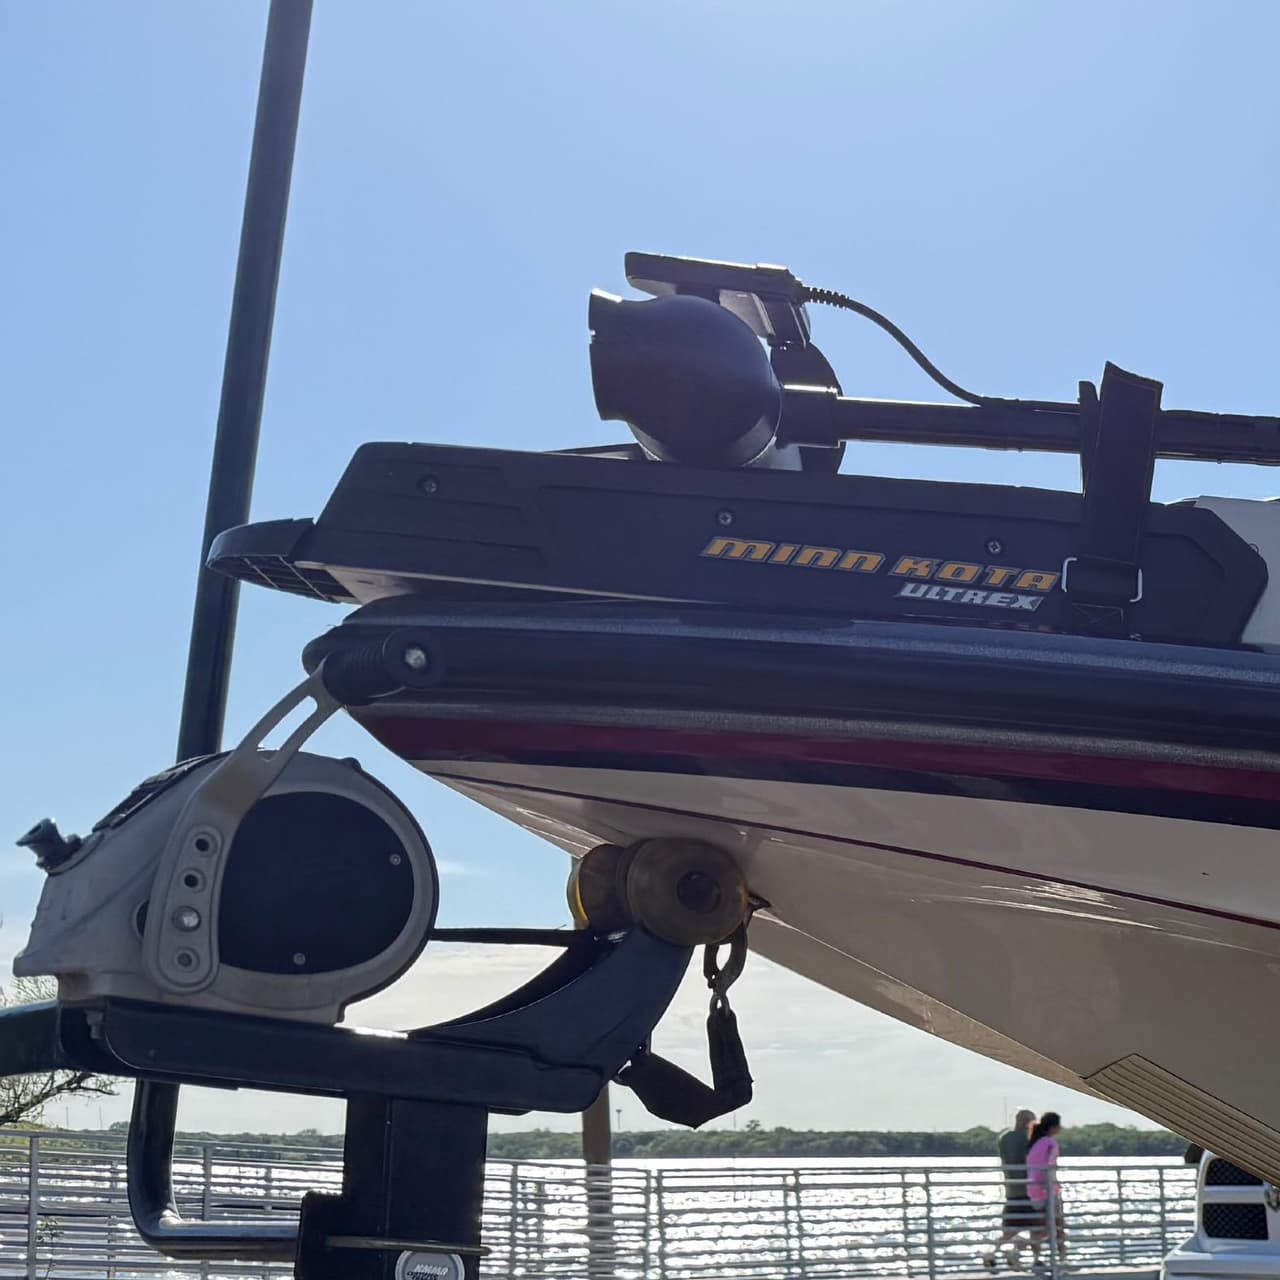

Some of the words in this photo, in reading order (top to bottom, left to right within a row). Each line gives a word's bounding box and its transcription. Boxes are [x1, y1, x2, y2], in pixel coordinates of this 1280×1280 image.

[702, 537, 885, 573] MINN
[890, 555, 1061, 592] KOTA
[898, 583, 1044, 612] ULTREX
